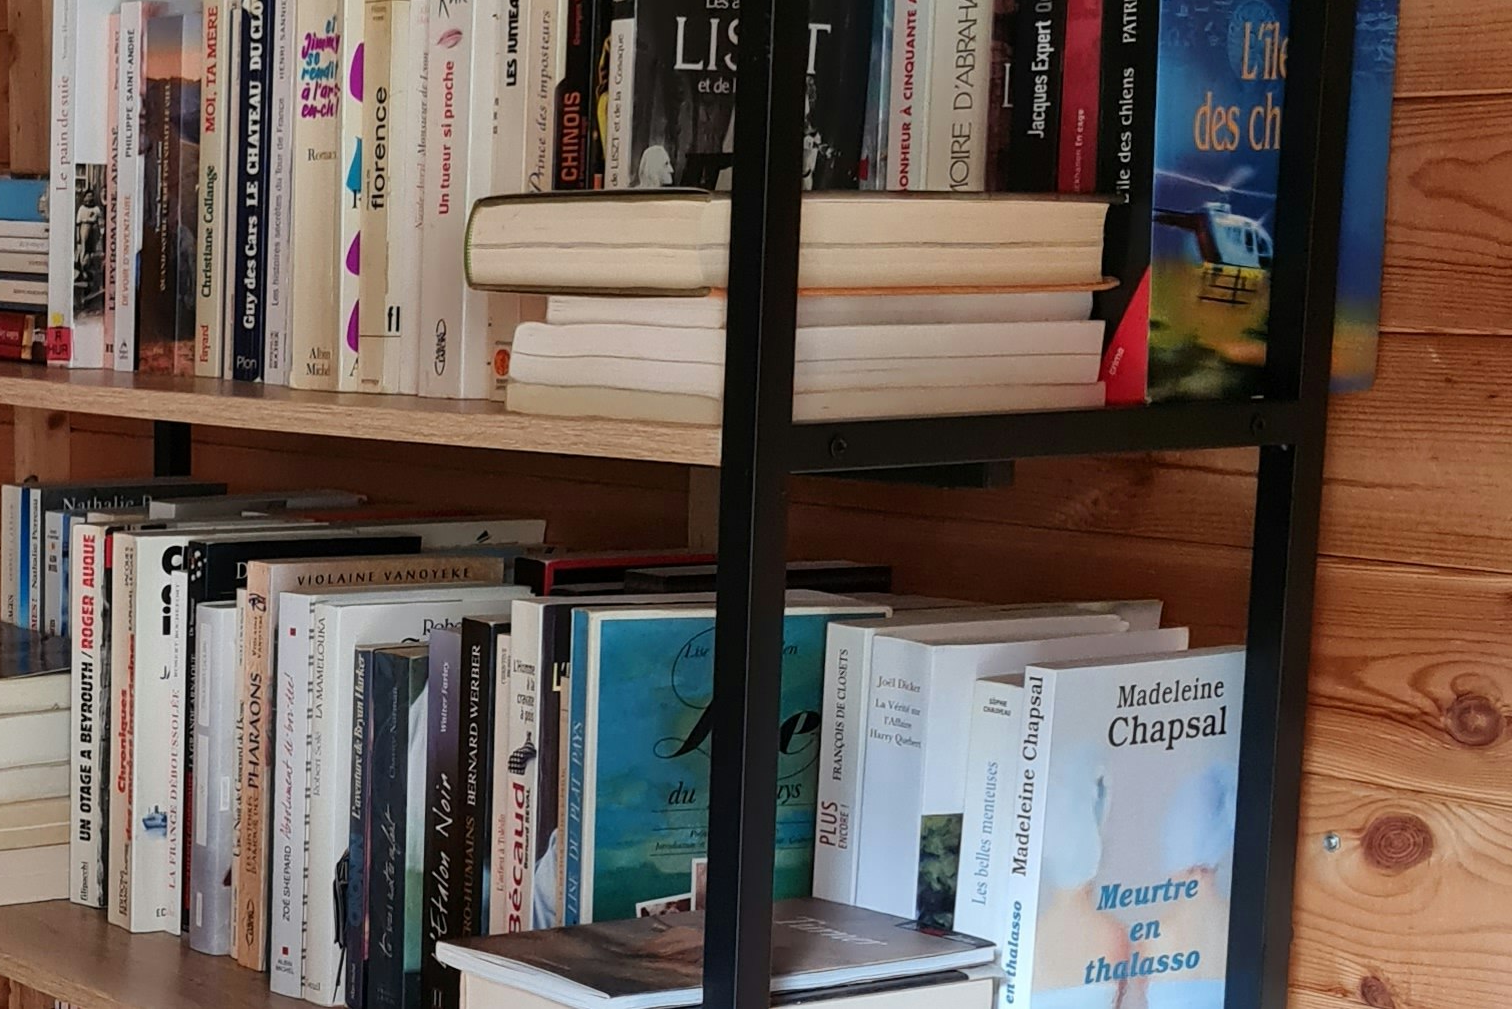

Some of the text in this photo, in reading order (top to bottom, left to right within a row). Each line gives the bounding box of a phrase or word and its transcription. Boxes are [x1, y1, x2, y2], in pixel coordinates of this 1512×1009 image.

[205, 5, 219, 133] MOI, TA MERE
[249, 43, 263, 70] DU
[506, 58, 517, 87] LES
[903, 3, 916, 101] CINQUANTE
[1027, 20, 1054, 139] Jacques Expert
[528, 10, 552, 192] Prince des imposteurs
[714, 77, 730, 93] de
[1118, 66, 1135, 164] des chiens
[56, 75, 70, 191] Le pain de suie
[124, 106, 134, 158] PHILIPPE
[248, 81, 262, 174] CHATEAU
[370, 87, 388, 211] florence
[439, 60, 455, 215] Un tueur si proche
[560, 91, 581, 182] CHINOIS
[1194, 91, 1239, 152] des
[247, 182, 259, 207] LE
[271, 97, 285, 285] histoires Tour France
[200, 165, 217, 298] Christiane Collange
[245, 216, 259, 256] Cars
[120, 268, 130, 307] DEVOIR
[244, 258, 258, 288] des
[243, 292, 258, 329] Guy
[199, 325, 210, 364] Fayard
[237, 355, 257, 370] Plon
[297, 567, 471, 587] VIOLAINE VANOYEKE
[79, 533, 97, 842] UN OTAGE BEYROUTH ROGER AUQUE
[316, 617, 327, 698] MAMELOUKA
[876, 675, 921, 693] Joël Dicker
[832, 648, 849, 782] FRANÇOIS DE CLOSETS
[875, 698, 910, 715] La Vérité
[1116, 678, 1225, 708] Madeleine
[116, 688, 128, 794] Chroniques
[246, 672, 263, 790] PHARAONS
[352, 653, 366, 820] L'aventure Bryan Harker
[467, 644, 481, 806] BERNARD WERBER
[869, 729, 922, 748] Harry Quebert
[1108, 706, 1228, 750] Chapsal
[435, 771, 451, 839] Noir
[667, 781, 697, 805] du
[1012, 675, 1044, 877] Madeleine Chapsal
[567, 721, 583, 915] LISE PLAT PAYS
[819, 800, 838, 848] PLUS
[838, 811, 850, 850] ENCORE
[972, 761, 998, 906] Les belles menteuses
[283, 845, 293, 899] SHEPARD
[1096, 878, 1199, 911] Meurtre
[1005, 901, 1023, 1004] en thalasso
[1129, 919, 1161, 942] en
[1084, 948, 1201, 986] thalasso
